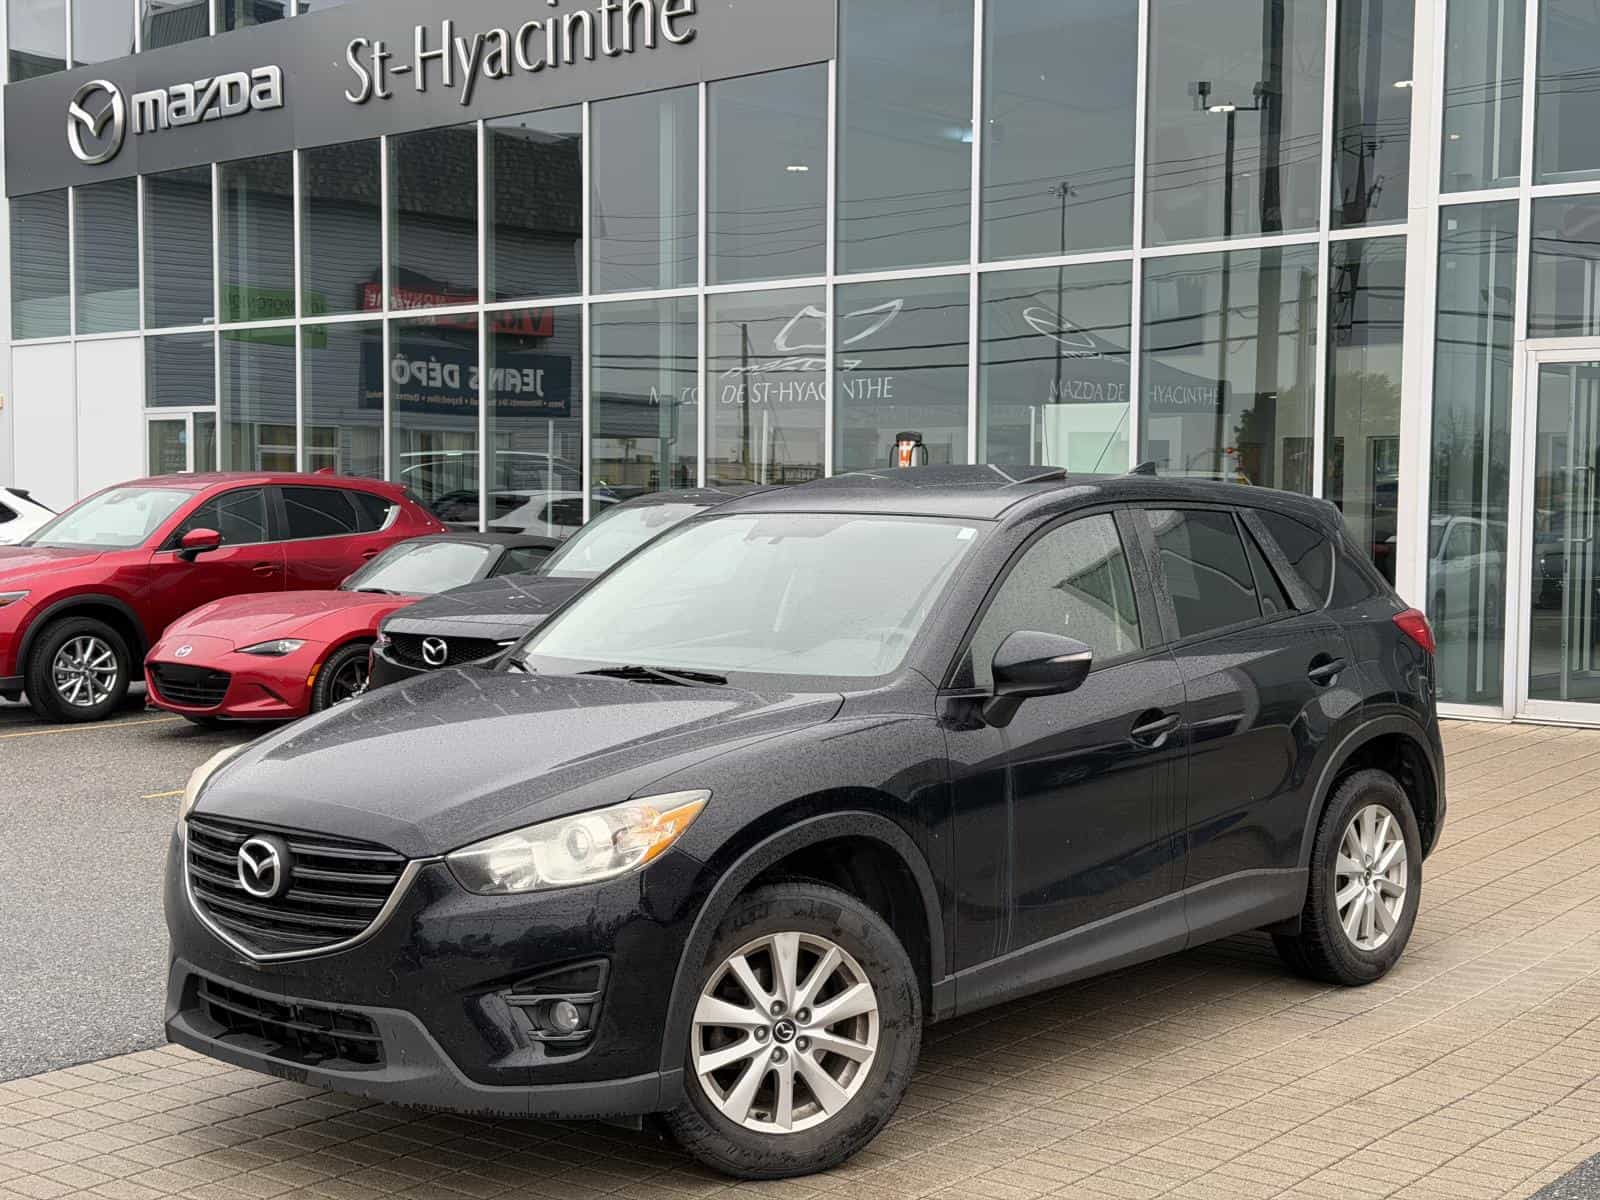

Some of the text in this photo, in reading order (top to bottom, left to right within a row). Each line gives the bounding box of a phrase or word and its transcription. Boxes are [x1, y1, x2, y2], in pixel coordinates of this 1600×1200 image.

[131, 0, 696, 134] mazda St-Hyacinthe
[751, 376, 894, 403] ST-HYACNTHE
[1107, 383, 1126, 402] DE
